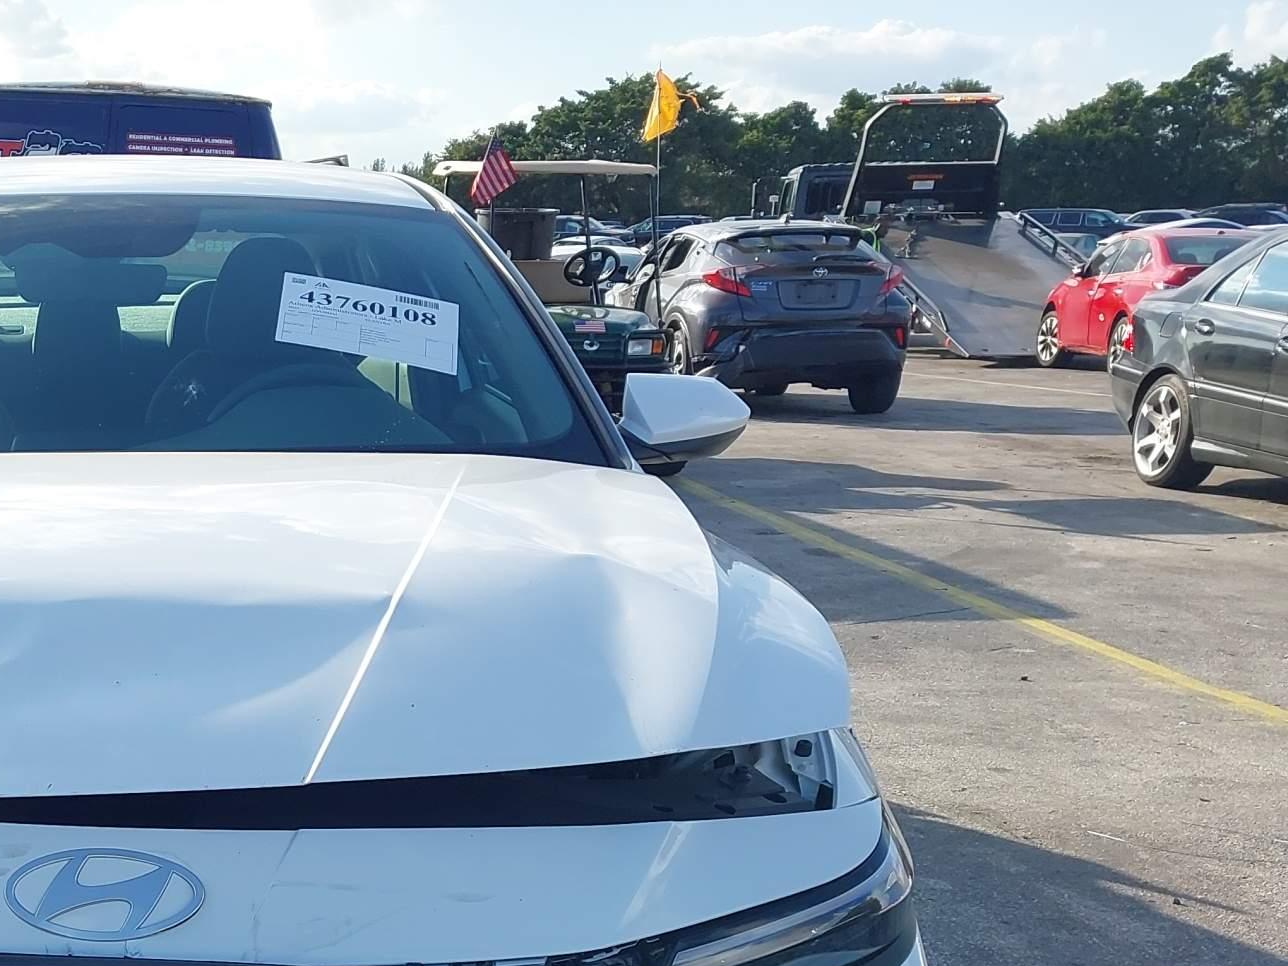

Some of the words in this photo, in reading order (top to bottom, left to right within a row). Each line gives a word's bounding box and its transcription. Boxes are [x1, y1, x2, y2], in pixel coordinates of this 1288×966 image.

[168, 135, 204, 143] COMMERCIAL
[151, 145, 183, 153] INSPECTION
[299, 290, 437, 326] 43760108
